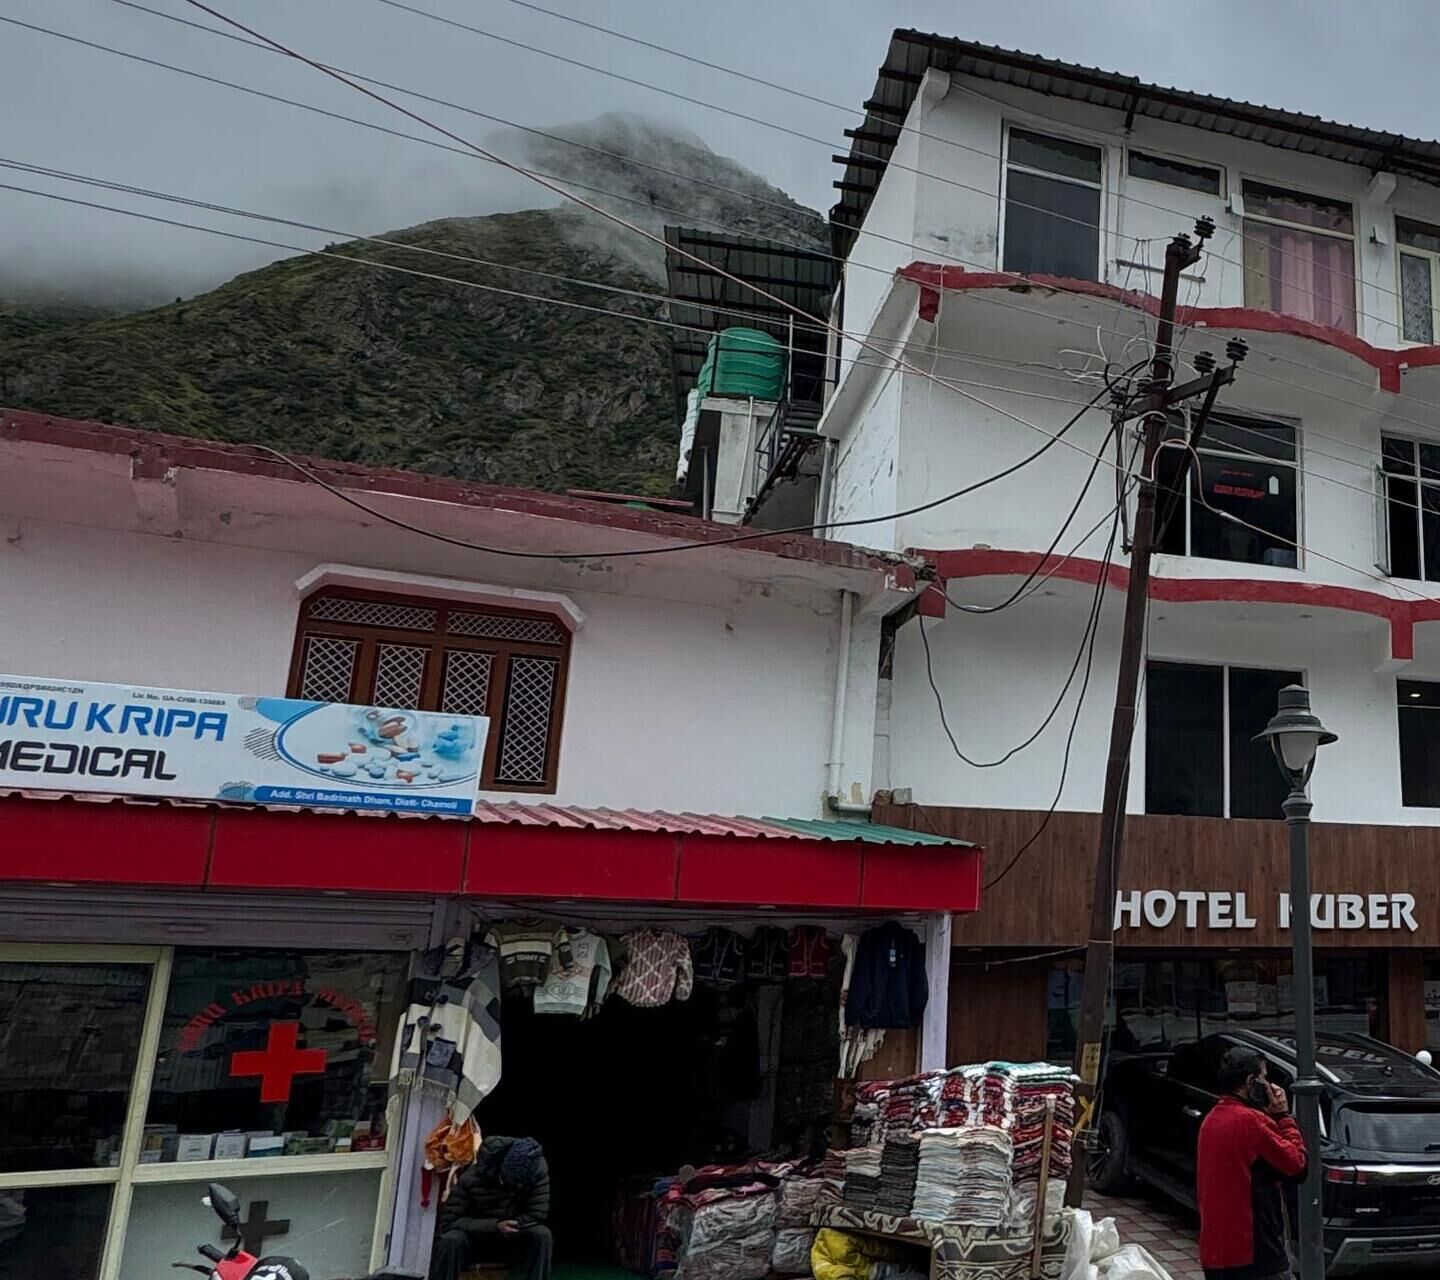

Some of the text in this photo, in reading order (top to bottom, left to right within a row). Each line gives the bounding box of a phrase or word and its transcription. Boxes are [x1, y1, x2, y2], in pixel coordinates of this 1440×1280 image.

[85, 702, 228, 742] KRIPA
[295, 790, 314, 802] Shri
[316, 792, 362, 804] Badrinath
[421, 798, 457, 810] Chamoli
[1113, 889, 1256, 931] HOTEL
